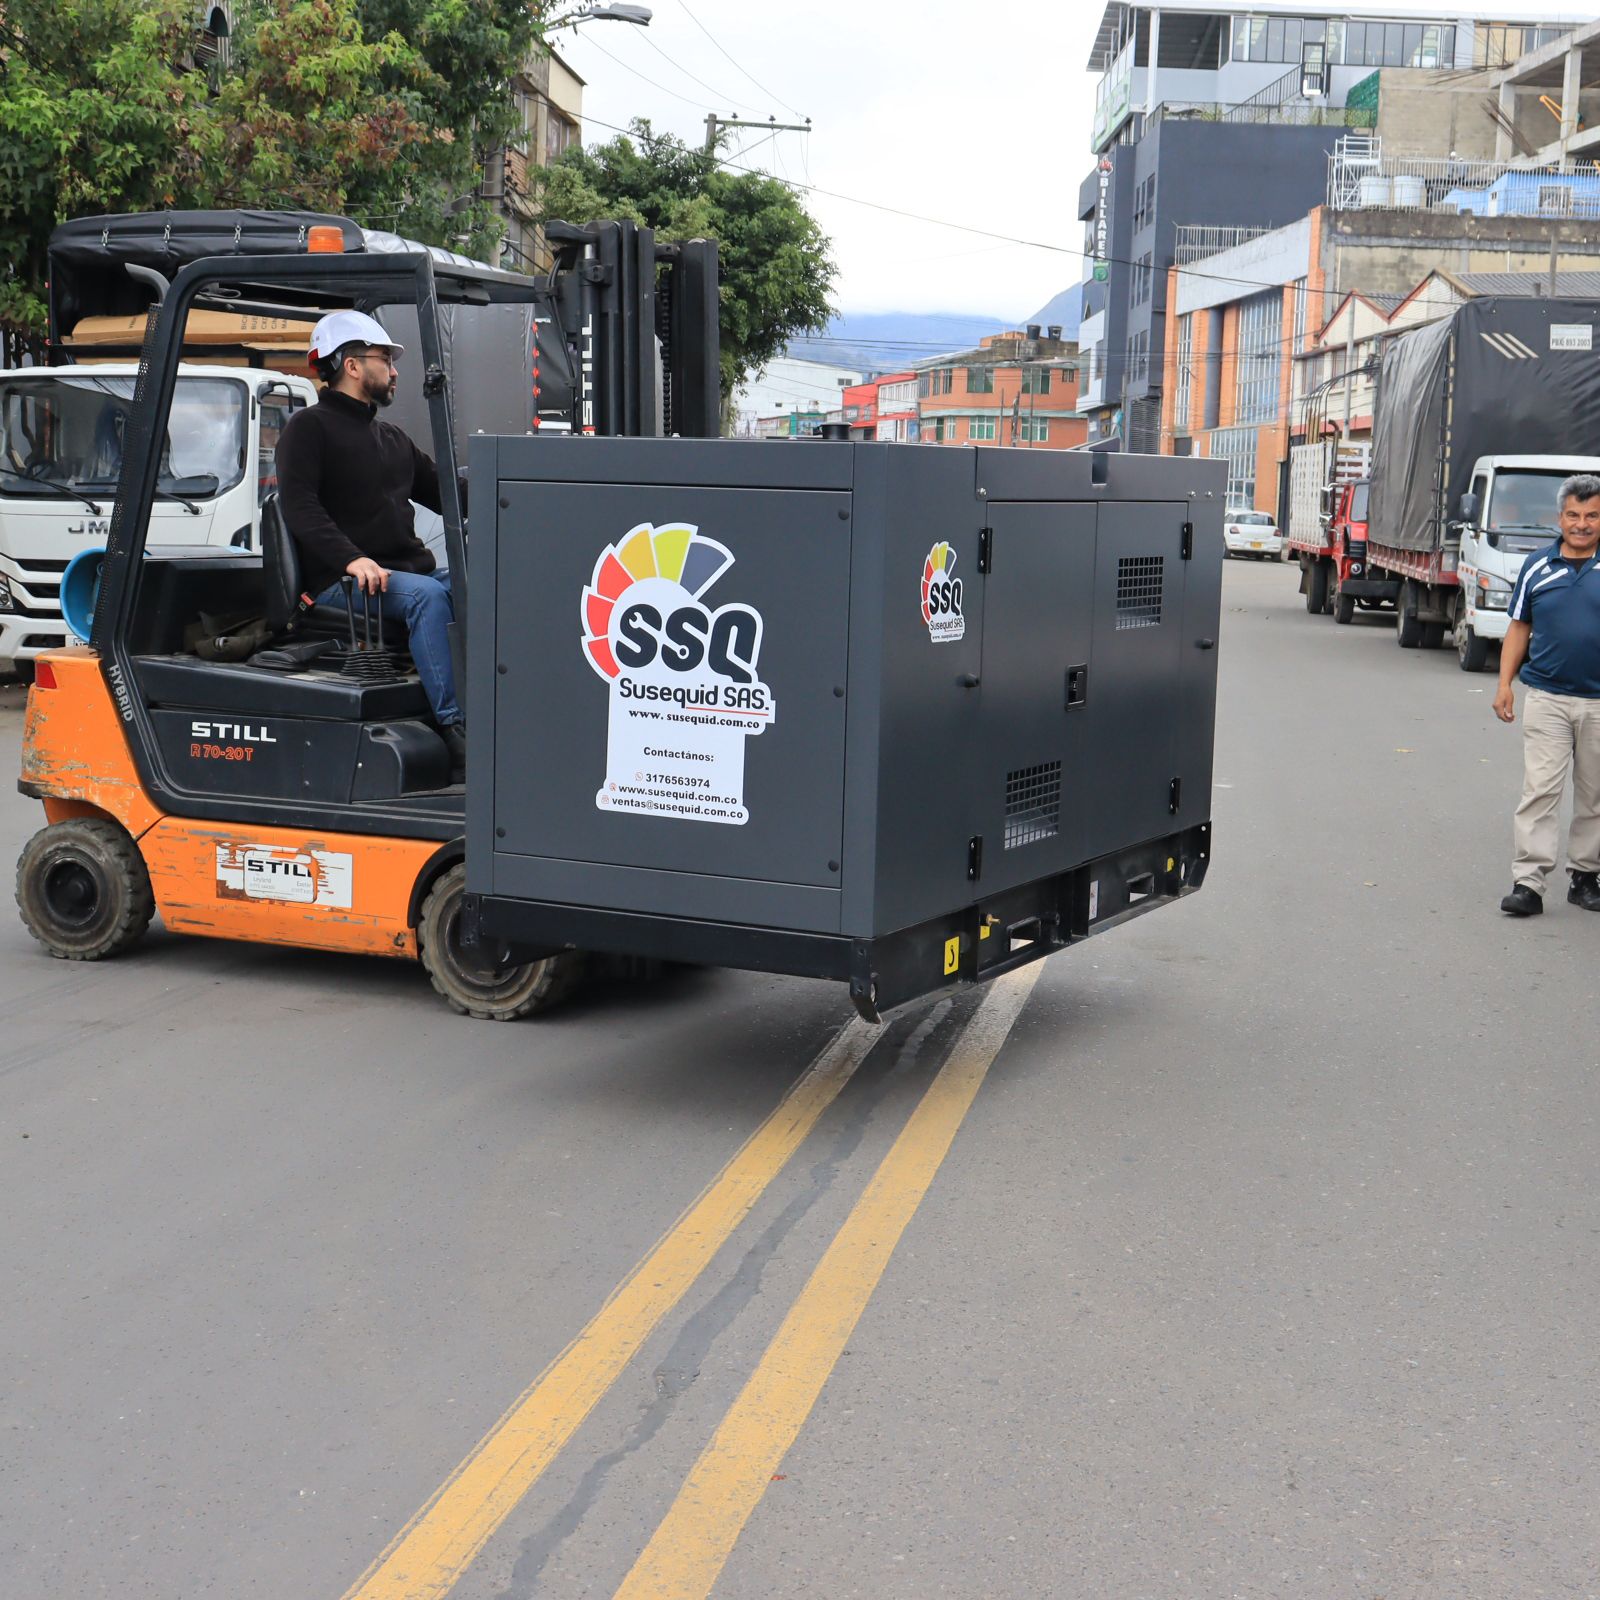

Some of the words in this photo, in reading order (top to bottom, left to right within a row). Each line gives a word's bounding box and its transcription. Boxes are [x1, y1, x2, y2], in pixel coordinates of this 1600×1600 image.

[1097, 177, 1109, 260] BILLARES
[581, 313, 592, 425] STILL
[68, 520, 109, 534] JM
[929, 581, 961, 616] SSQ
[930, 618, 953, 632] Susequid
[616, 603, 757, 684] SSQ
[109, 664, 133, 722] HYBRID
[619, 677, 719, 709] Susequid
[723, 685, 770, 711] SAS.
[666, 712, 760, 729] susequid.com.co
[191, 721, 277, 743] STILL
[643, 746, 715, 762] Contactános:
[645, 773, 711, 789] 3176563974
[618, 784, 738, 805] www.susequid.com.co
[611, 797, 744, 819] ventas@susequid.com.co
